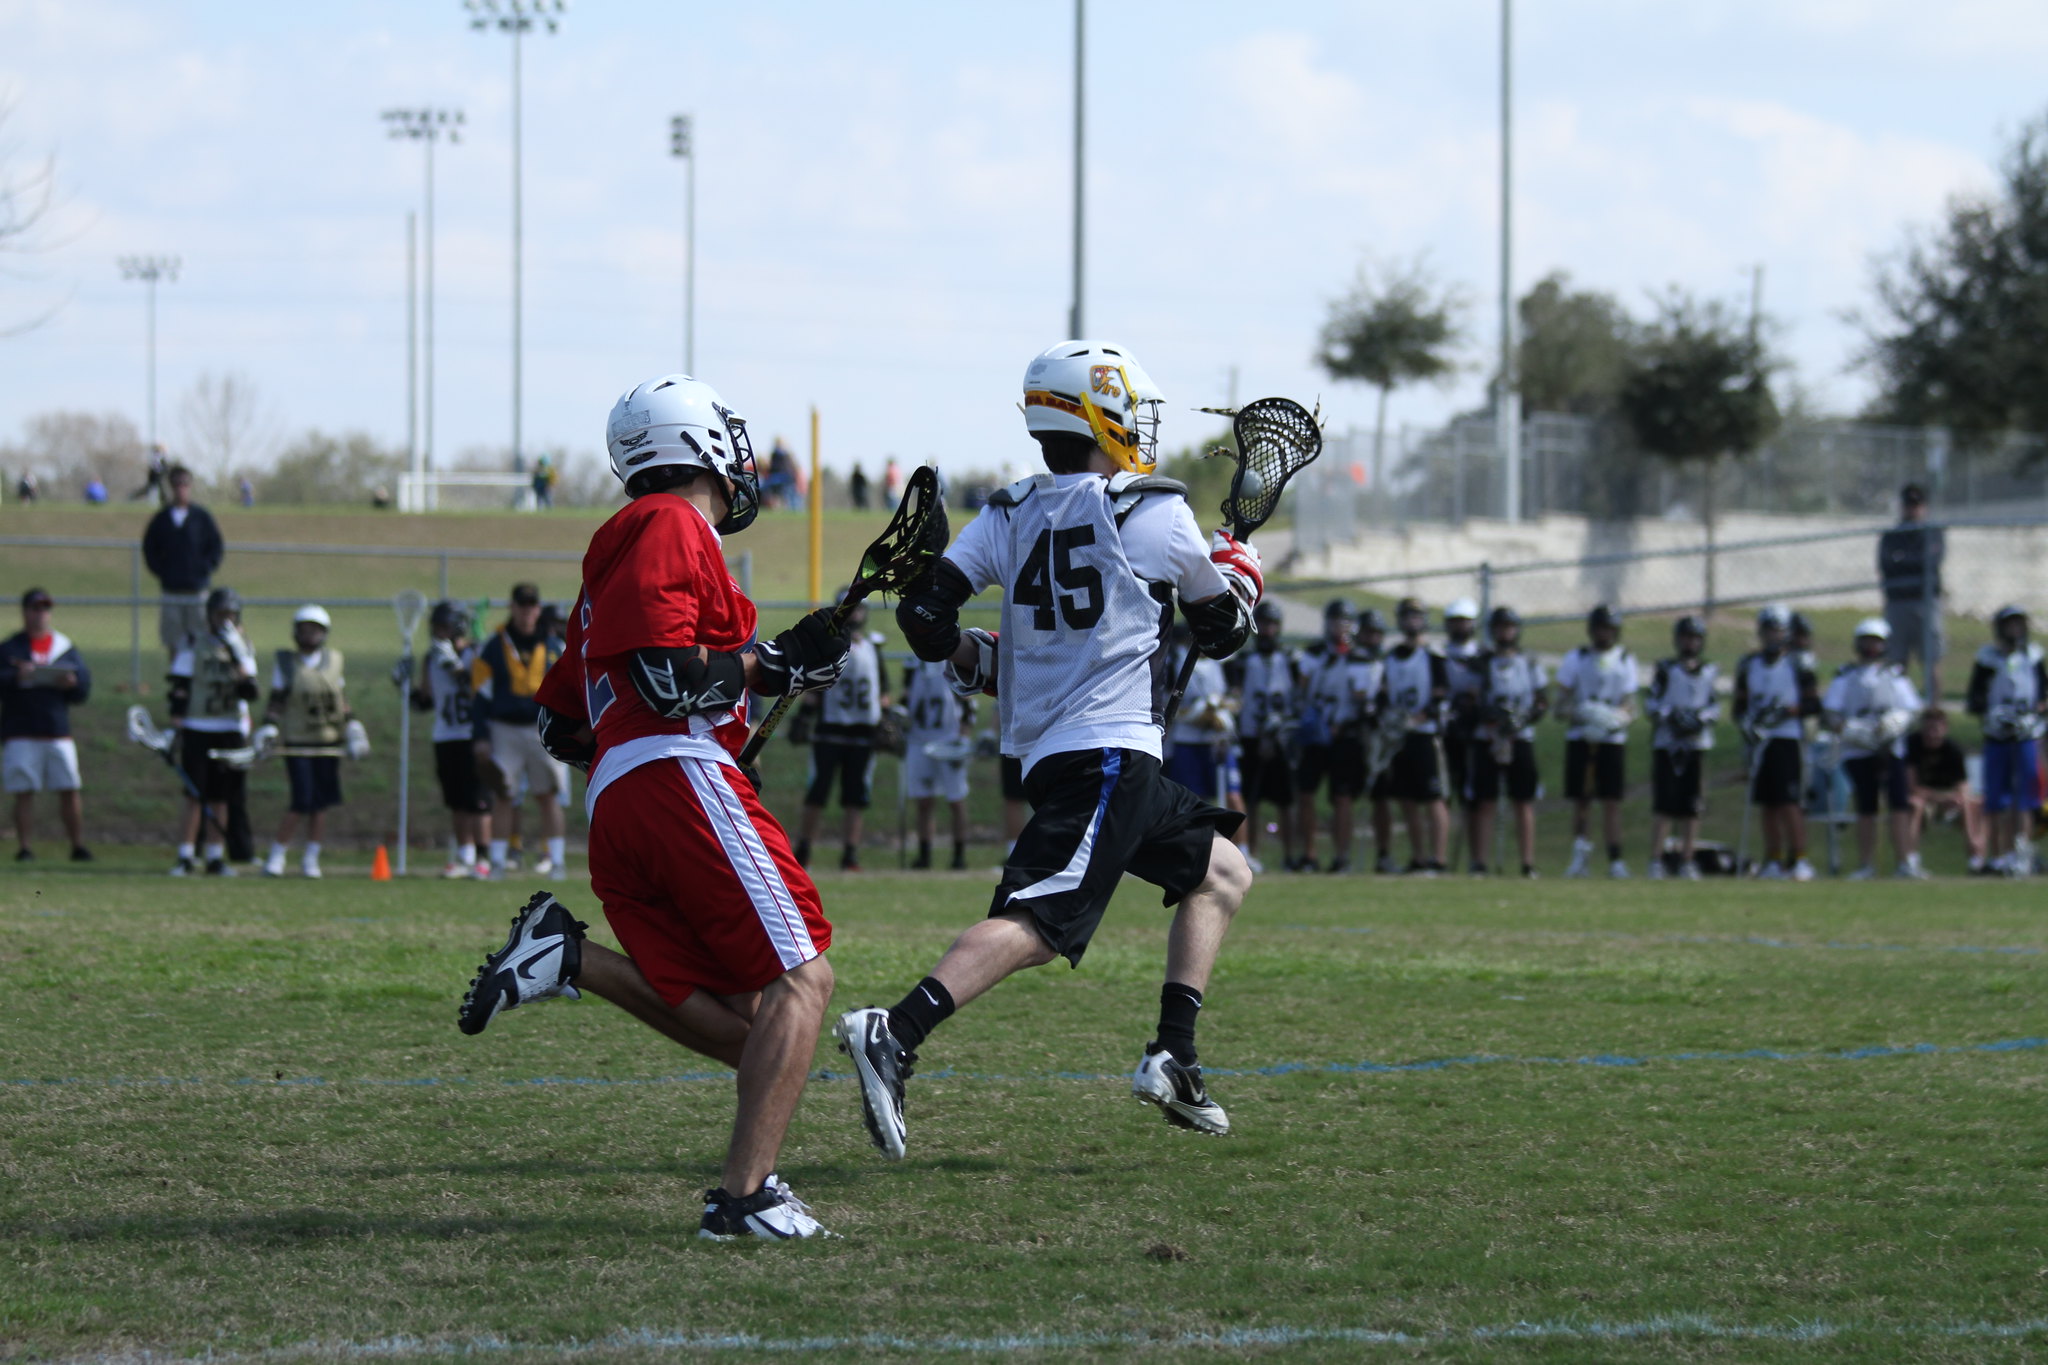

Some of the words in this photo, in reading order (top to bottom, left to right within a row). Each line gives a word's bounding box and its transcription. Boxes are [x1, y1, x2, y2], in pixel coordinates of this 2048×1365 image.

[1012, 523, 1105, 631] 45
[914, 605, 936, 622] STX
[788, 665, 804, 696] STX
[839, 677, 871, 710] 32
